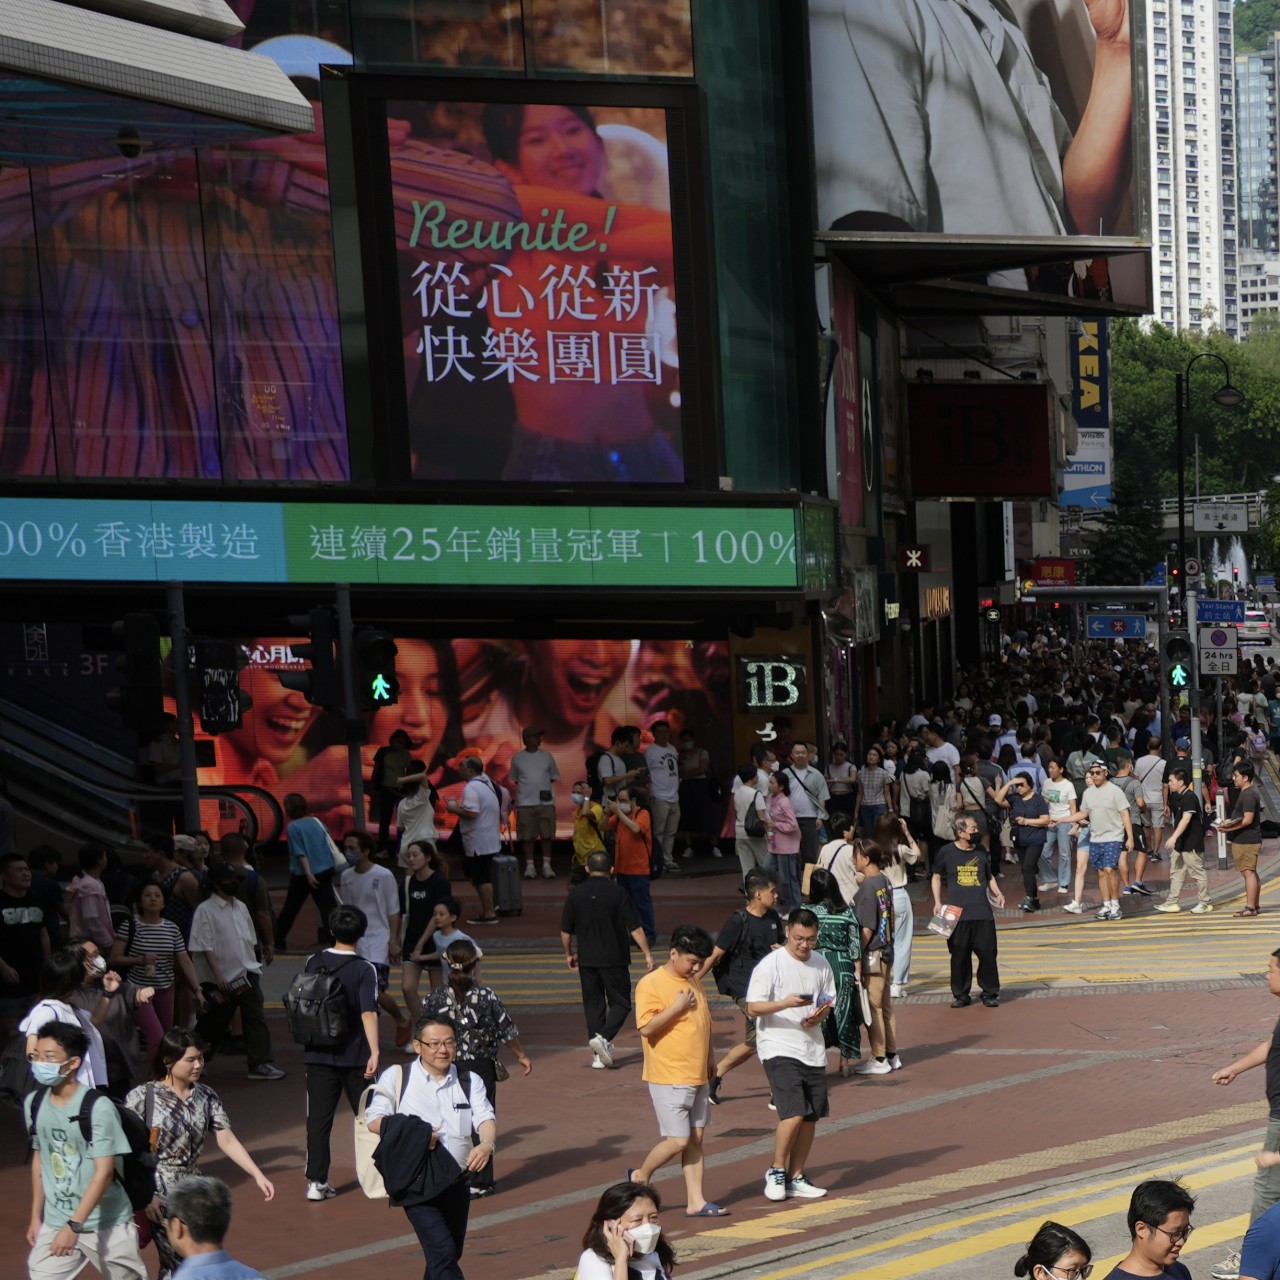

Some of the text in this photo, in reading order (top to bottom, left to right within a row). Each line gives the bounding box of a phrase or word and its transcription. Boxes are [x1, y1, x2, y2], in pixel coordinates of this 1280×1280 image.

[408, 200, 619, 254] Reunite!
[411, 263, 662, 323] 從心從新
[416, 330, 664, 387] 快樂團圓
[1078, 321, 1101, 411] KEA
[1065, 463, 1103, 473] CATHLON
[93, 520, 262, 560] 香港製造
[309, 524, 797, 566] 連續25年銷量冠軍 100%
[1204, 611, 1231, 620] 的士站
[80, 653, 109, 675] 3F
[1204, 651, 1233, 660] 24 hrs
[1207, 661, 1230, 672] 全日
[745, 661, 799, 707] iB
